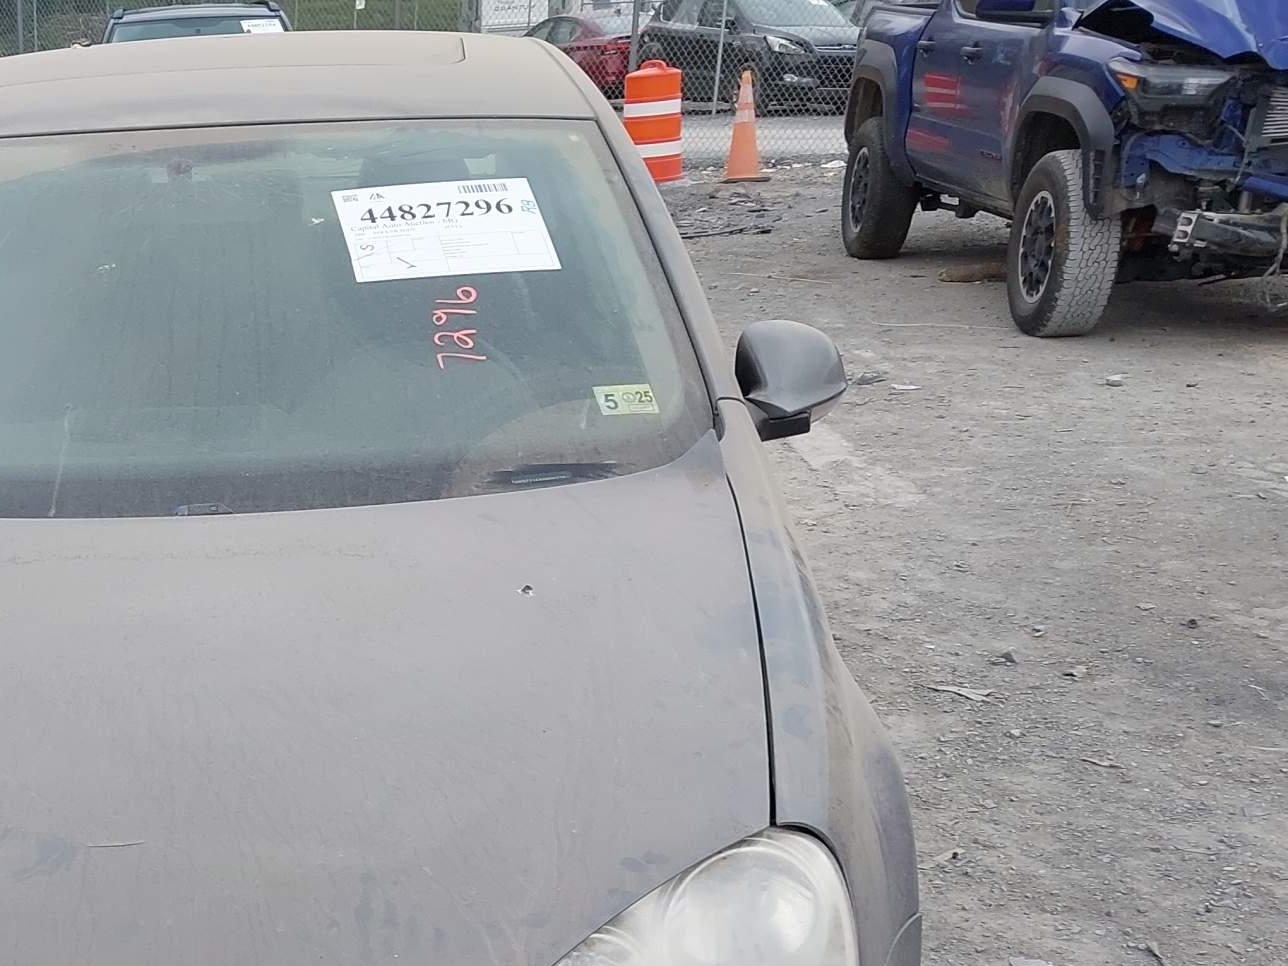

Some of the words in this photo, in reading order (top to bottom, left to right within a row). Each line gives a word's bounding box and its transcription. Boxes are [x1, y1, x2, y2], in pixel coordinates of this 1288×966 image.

[360, 198, 513, 224] 44827296
[432, 286, 487, 369] 7296
[603, 393, 619, 410] 5
[635, 391, 653, 403] 25
